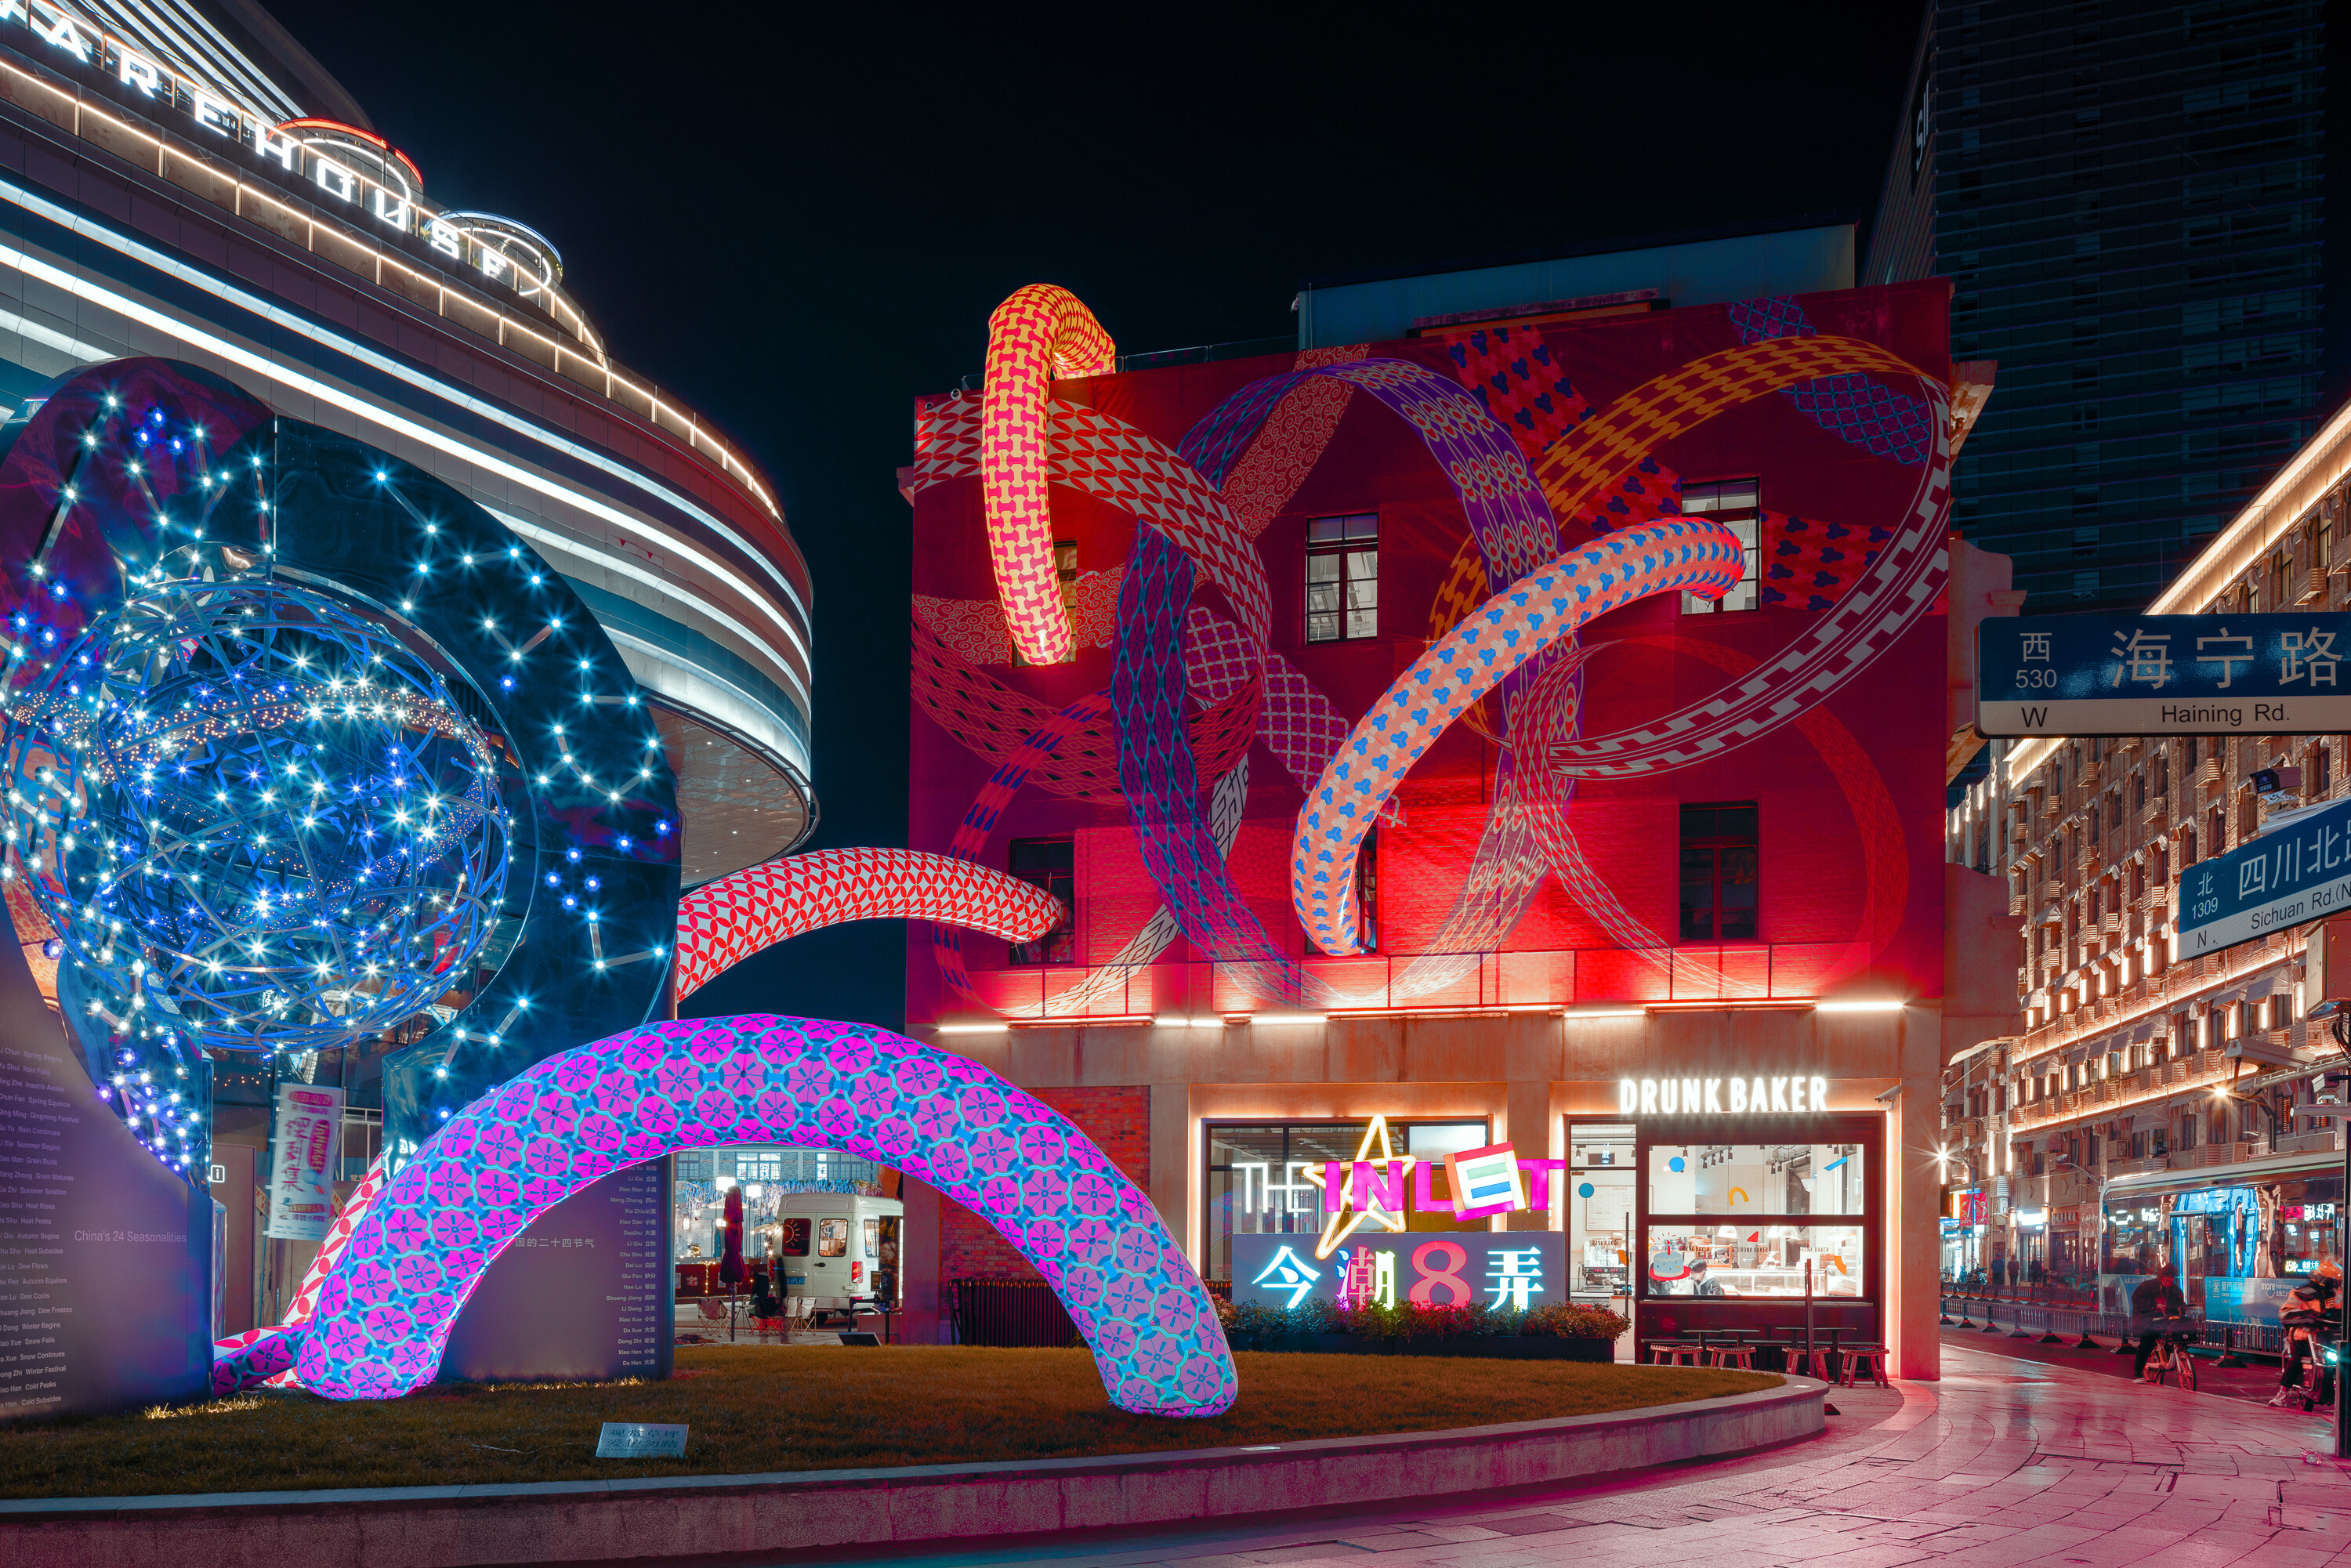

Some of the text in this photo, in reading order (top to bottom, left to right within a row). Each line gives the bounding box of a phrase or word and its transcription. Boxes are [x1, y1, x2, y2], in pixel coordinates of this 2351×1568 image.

[2020, 632, 2052, 662] 西
[2111, 626, 2343, 690] 海宁路
[2015, 669, 2057, 689] 530
[2021, 707, 2048, 728] W
[2161, 704, 2291, 727] Haining Rd.
[2239, 820, 2351, 901] 四川北
[2197, 871, 2214, 897] 北
[2191, 897, 2219, 920] 1309
[2251, 901, 2305, 930] Sichuan
[1619, 1076, 1828, 1114] DRUNK BAKER
[1232, 1162, 1314, 1213] THE
[1324, 1141, 1566, 1222] INLET
[74, 1229, 187, 1243] China's 24 Seasonalities
[515, 1237, 595, 1248] 国的二十四节气
[1252, 1240, 1545, 1313] 今潮8弄
[2261, 1282, 2276, 1291] more
